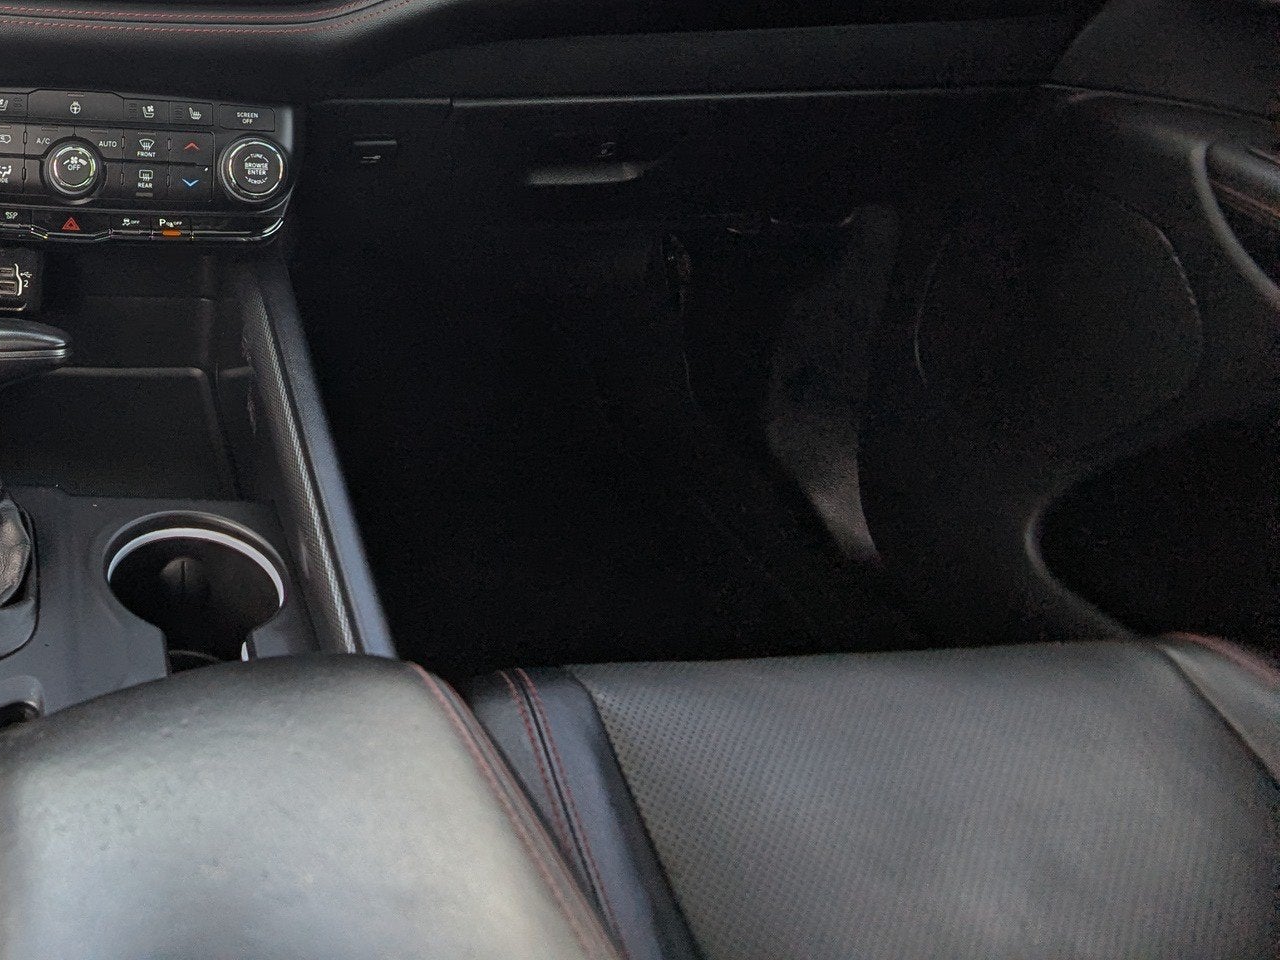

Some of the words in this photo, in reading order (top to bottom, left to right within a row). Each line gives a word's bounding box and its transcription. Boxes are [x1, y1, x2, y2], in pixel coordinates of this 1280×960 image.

[36, 137, 51, 145] A/C
[98, 140, 118, 148] AUTO
[67, 164, 81, 172] OFF
[23, 280, 29, 288] 2
